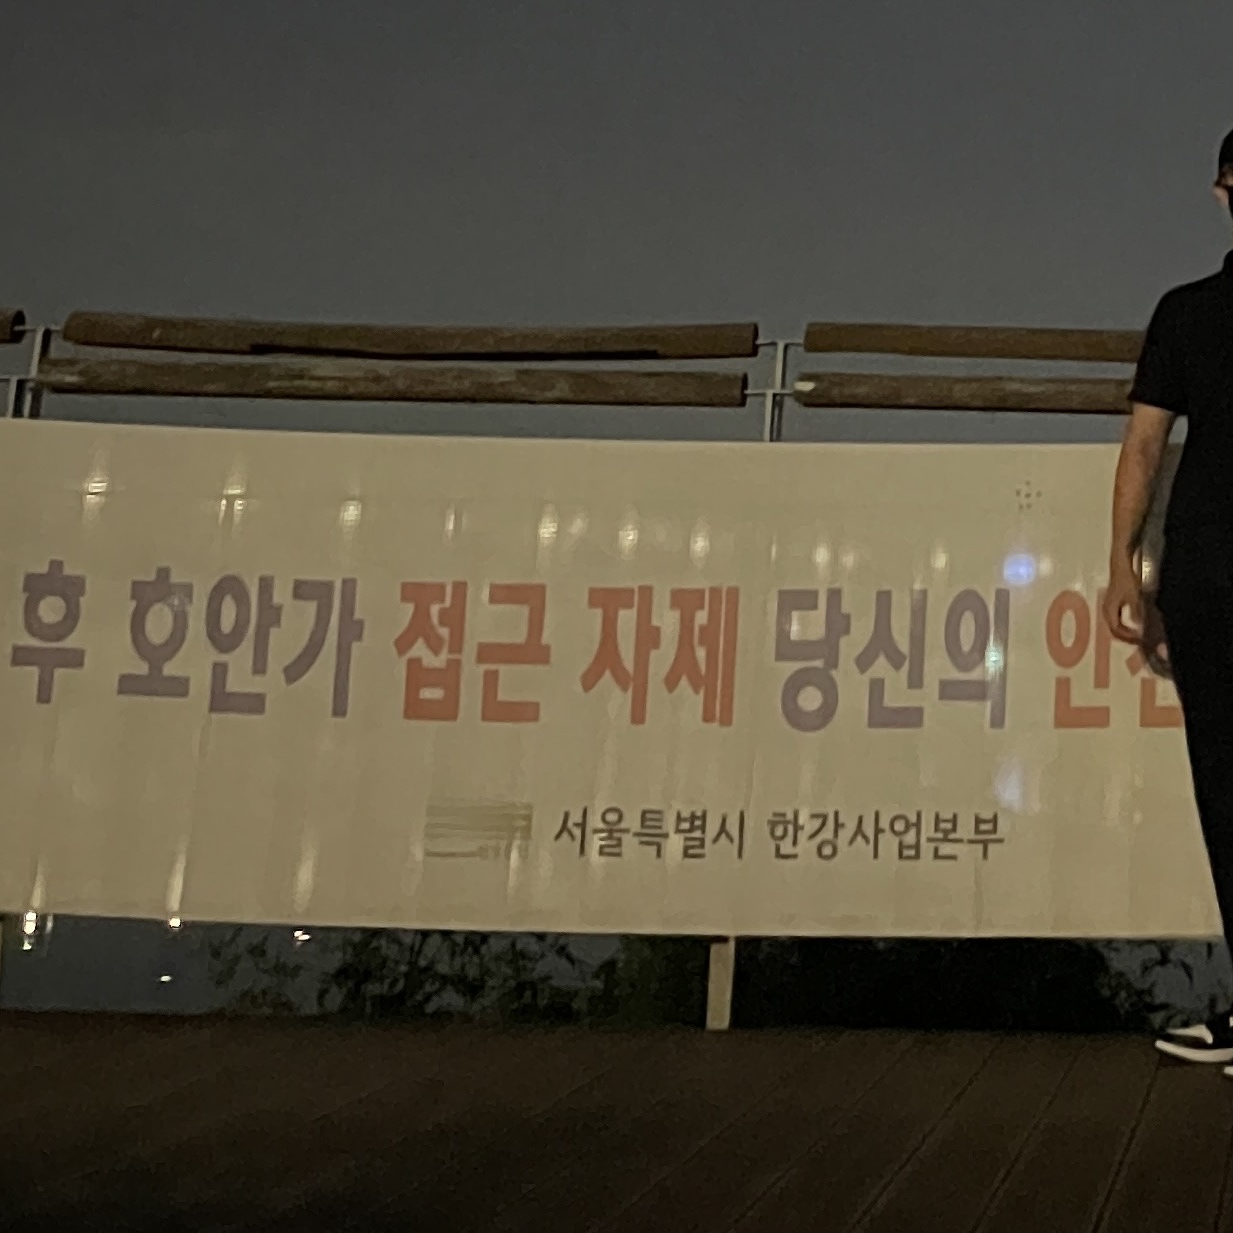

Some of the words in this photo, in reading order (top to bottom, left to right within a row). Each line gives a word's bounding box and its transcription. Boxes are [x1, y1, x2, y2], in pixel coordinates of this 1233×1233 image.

[11, 559, 87, 704] 후
[117, 566, 365, 718] 호안가
[394, 581, 551, 723] 접근
[581, 585, 740, 727] 자제
[775, 587, 1010, 733] 당신의
[553, 805, 747, 861] 서울특별시
[766, 808, 1006, 862] 한강사업본부
